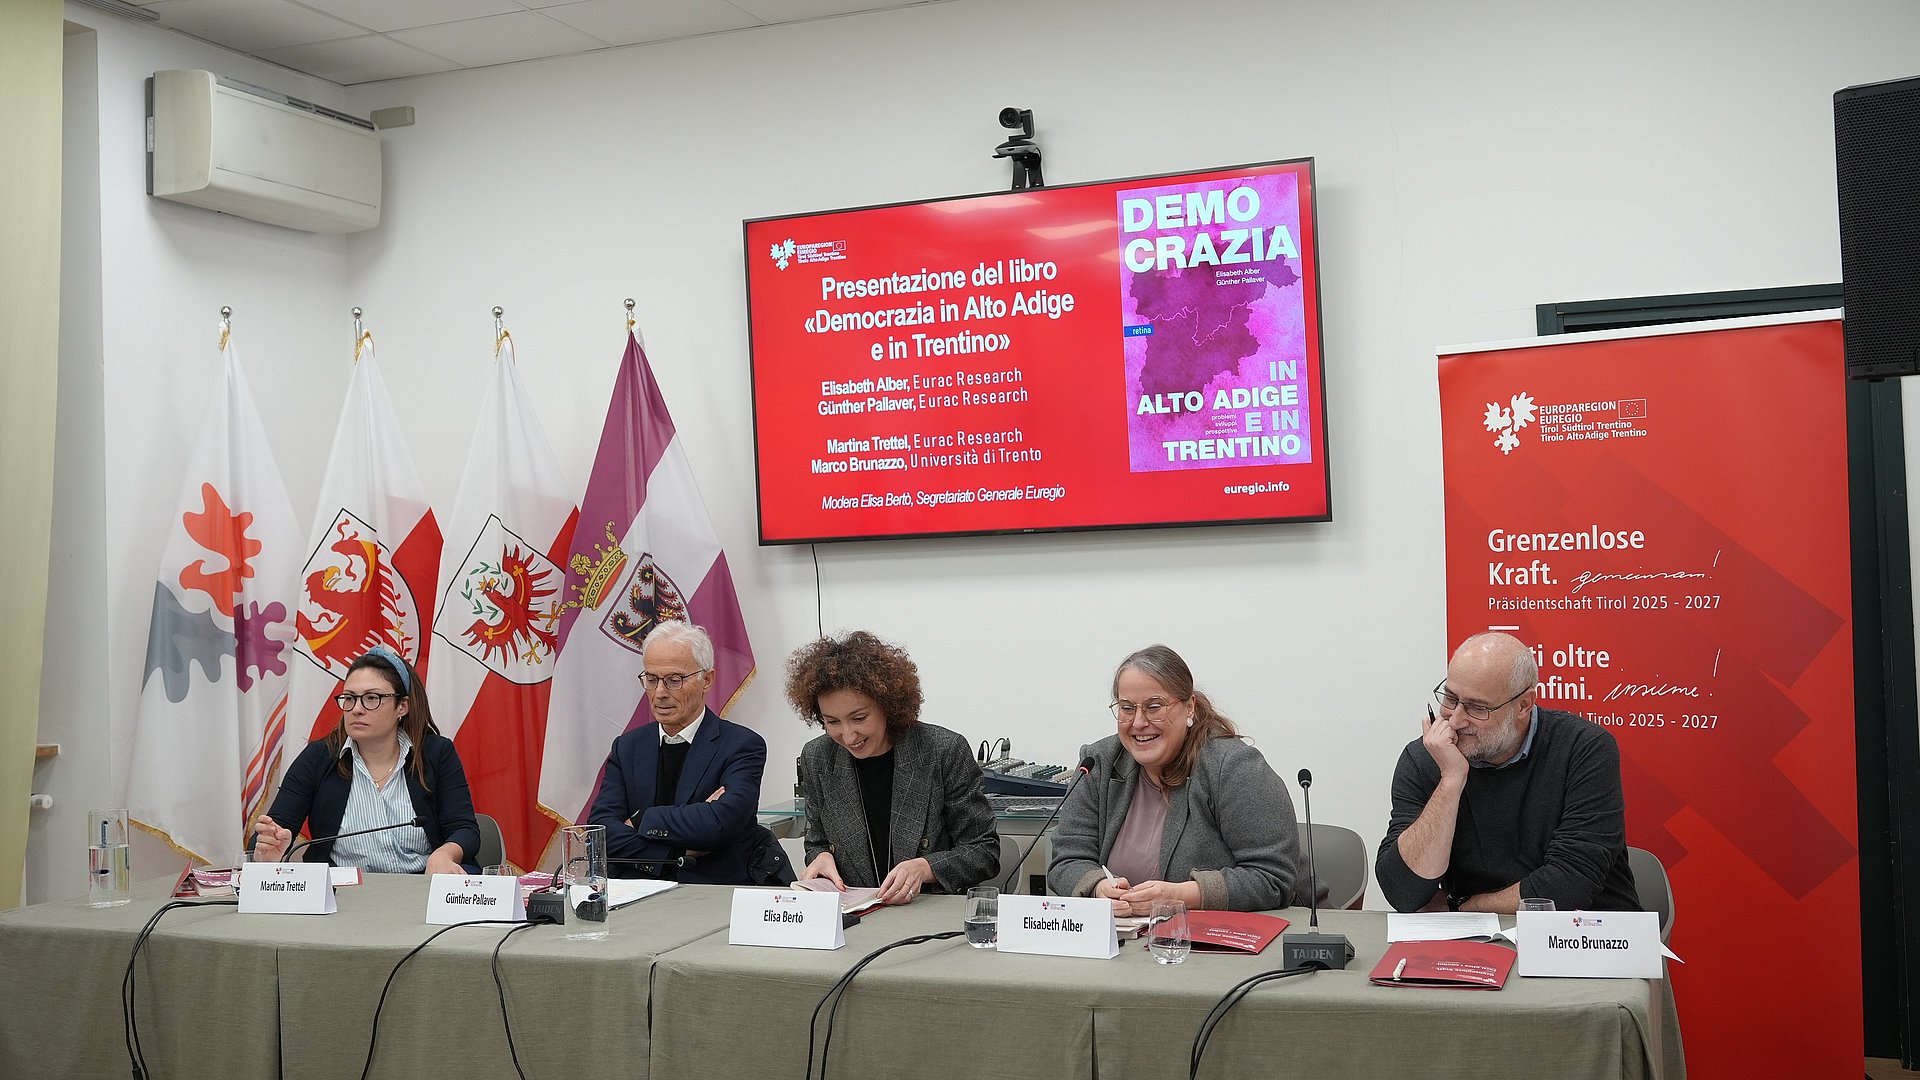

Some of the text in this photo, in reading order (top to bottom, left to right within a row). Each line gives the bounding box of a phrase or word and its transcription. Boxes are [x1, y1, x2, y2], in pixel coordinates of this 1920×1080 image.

[1123, 187, 1260, 232] DEMO
[1124, 225, 1299, 272] CRAZIA
[822, 259, 1057, 300] Presentazione del libro
[1216, 268, 1260, 278] Elisabeth Alber
[1216, 276, 1265, 286] Günther Pallaver
[804, 290, 1075, 333] «Democrazia in Alto Adige
[1132, 326, 1151, 335] retina
[871, 330, 1011, 360] e in Trentino»
[1269, 360, 1297, 380] IN
[822, 367, 1022, 395] Elisabeth Alber, Eurac Research
[818, 388, 1028, 415] Günther Pallaver, Eurac Research
[1137, 386, 1298, 415] ALTO ADIGE
[1539, 401, 1616, 415] EUROPAREGION
[1246, 410, 1299, 432] E IN
[1539, 412, 1582, 424] EUREGIO
[1541, 419, 1632, 433] Tirol Südtirol Trentino
[827, 428, 1023, 454] Martina Trettel, Eurac Research
[1205, 427, 1237, 435] prospettive
[1541, 432, 1564, 442] Tirolo
[1611, 428, 1647, 438] Trentino
[1163, 434, 1300, 461] TRENTINO
[811, 447, 1042, 473] Marco Brunazzo, Università di Trento
[822, 484, 1065, 509] Modera Elisa Bertò, Segretariato Generale Euregio
[1224, 481, 1289, 495] euregio.info
[1488, 525, 1645, 552] Grenzenlose
[1489, 561, 1558, 586] Kraft.
[1488, 596, 1592, 611] Präsidentschaft
[1596, 596, 1626, 609] Tirol
[1632, 596, 1668, 609] 2025
[1685, 595, 1720, 609] 2027
[1552, 644, 1610, 668] oltre
[1536, 676, 1593, 700] nfini.
[1588, 712, 1624, 727] Tirolo
[1629, 713, 1664, 727] 2025
[1682, 714, 1718, 729] 2027
[260, 881, 306, 892] Martina Trettel
[445, 893, 497, 906] Günther Pallaver
[763, 909, 804, 923] Elisa Bertò
[1023, 917, 1083, 932] Elisabeth Alber
[1548, 935, 1629, 950] Marco Brunazzo
[1292, 948, 1334, 960] TAIDEN
